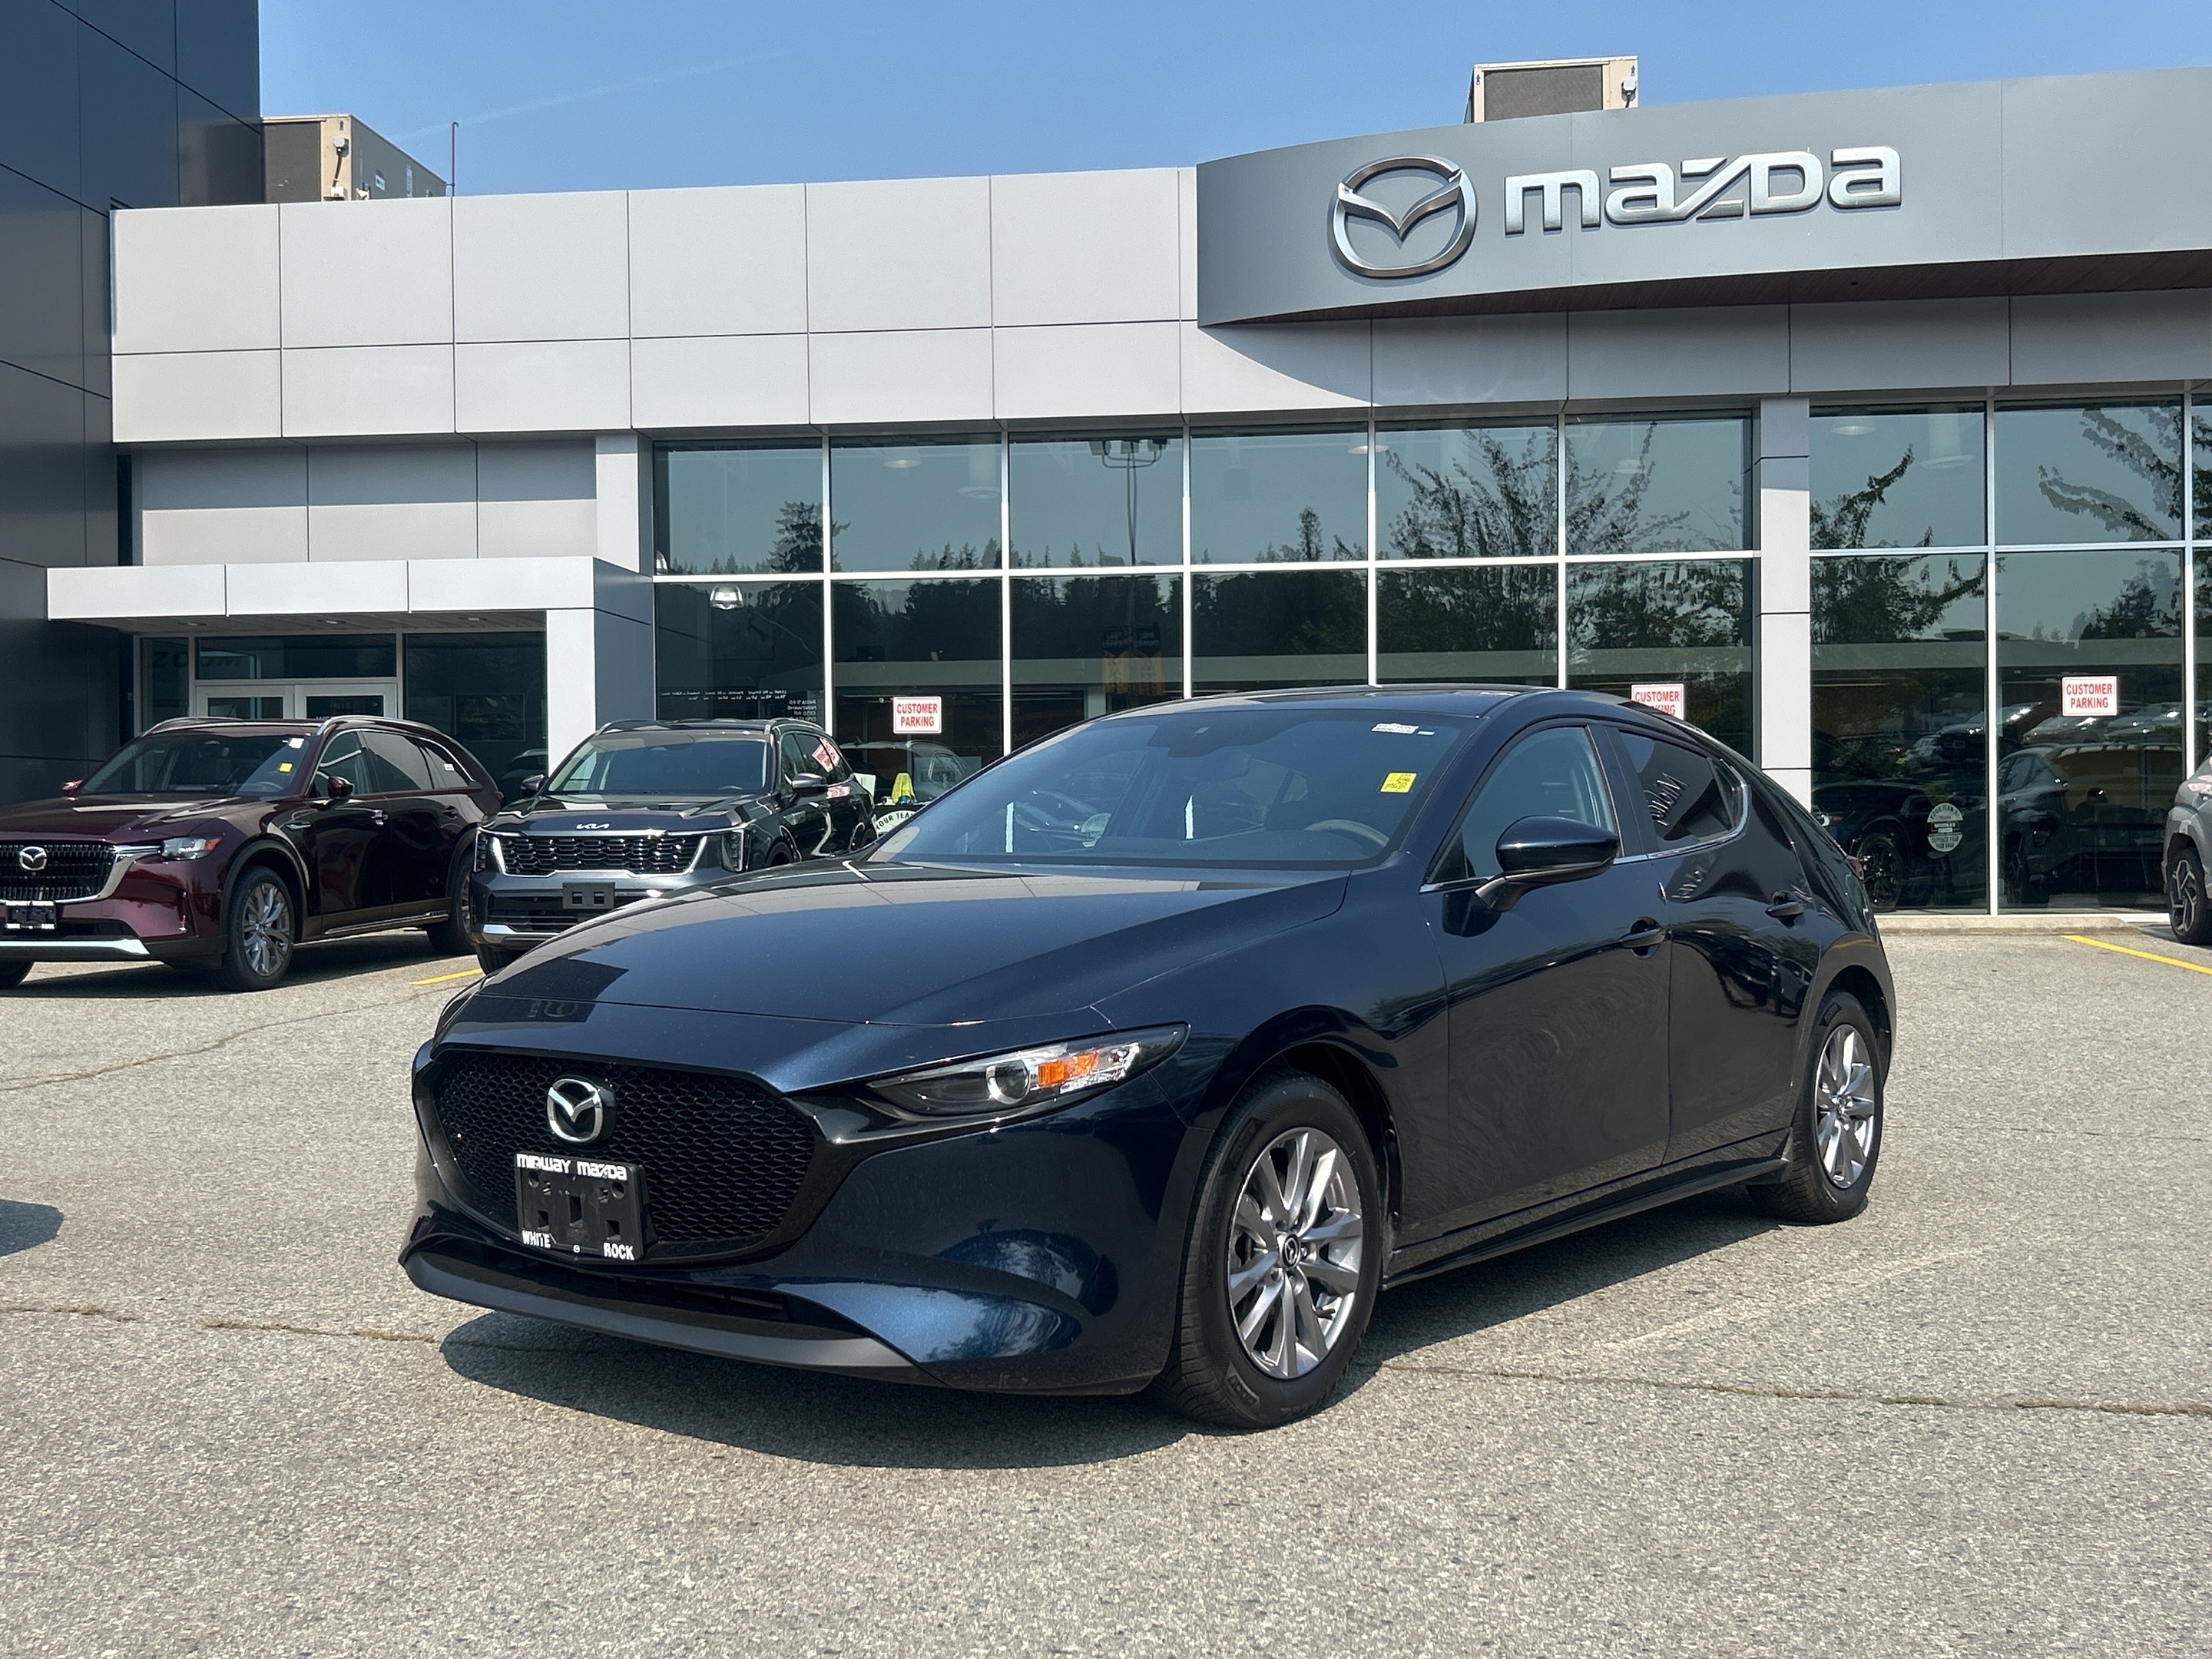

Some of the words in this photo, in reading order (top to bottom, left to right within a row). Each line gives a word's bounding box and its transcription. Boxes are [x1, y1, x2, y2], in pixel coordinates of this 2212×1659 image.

[2066, 684, 2113, 695] CUSTOMER
[1635, 691, 1680, 701] CUSTOMER
[2071, 697, 2108, 709] PARKING
[897, 704, 938, 714] CUSTOMER
[901, 717, 935, 727] PARKING
[522, 1230, 551, 1248] WHITE
[603, 1242, 634, 1260] ROCK
